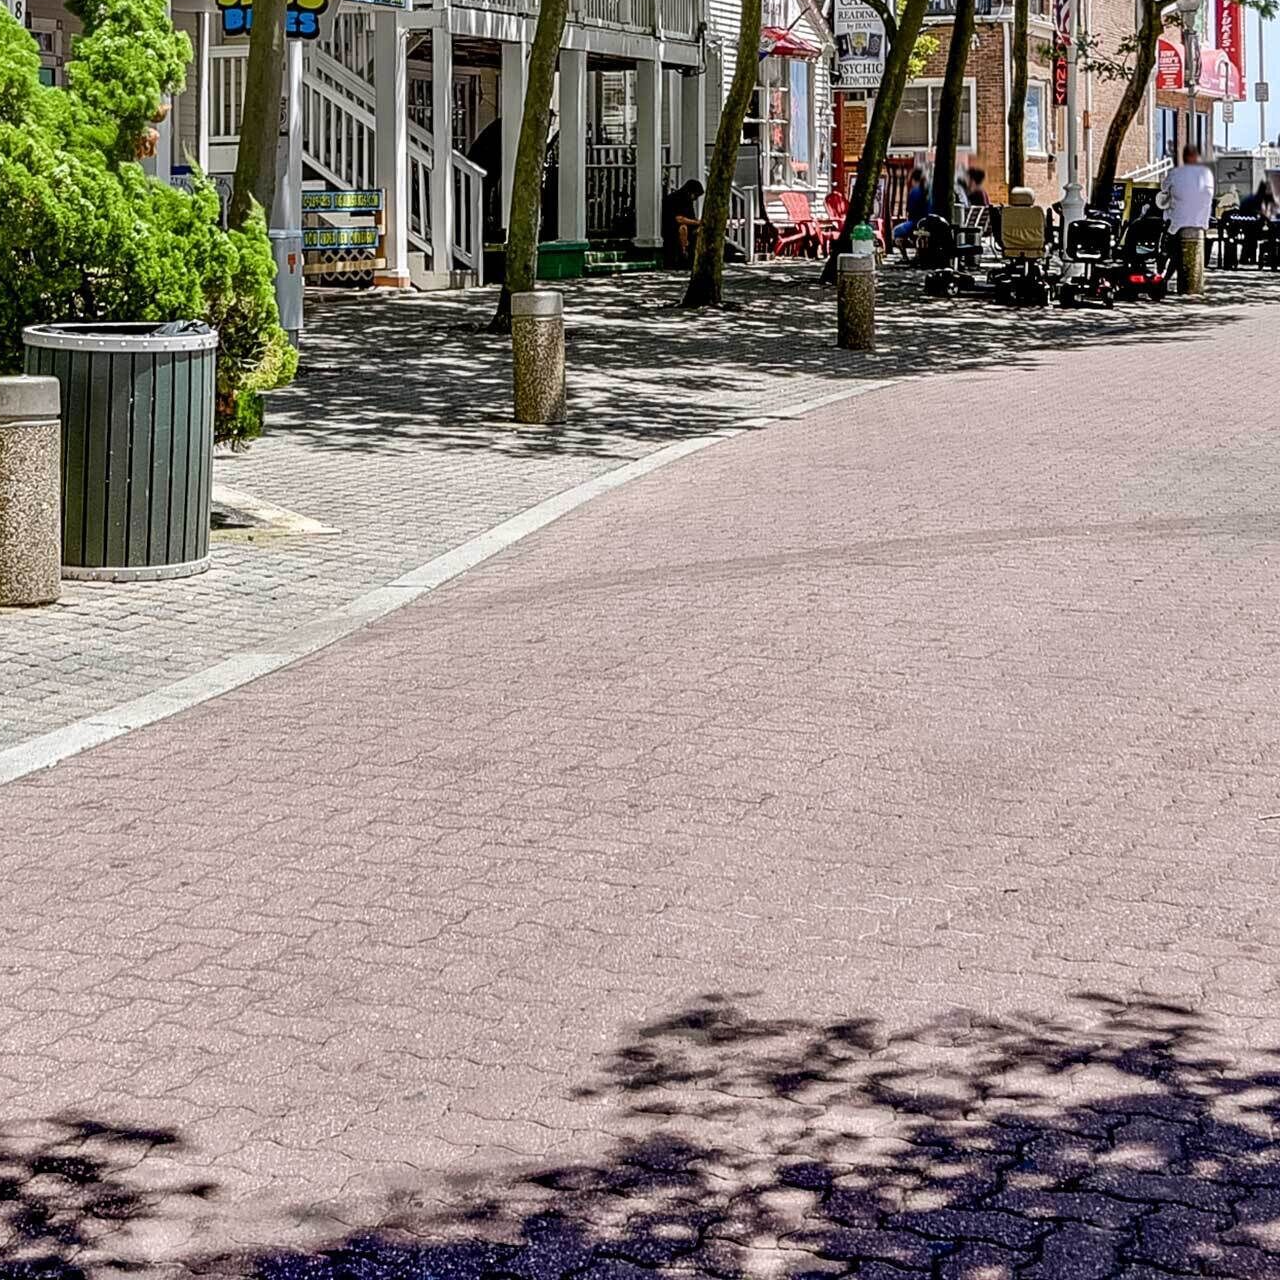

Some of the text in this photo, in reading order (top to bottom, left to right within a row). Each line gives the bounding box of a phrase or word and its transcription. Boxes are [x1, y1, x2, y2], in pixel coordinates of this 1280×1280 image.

[15, 1, 22, 19] 8
[224, 8, 316, 32] BIES
[838, 63, 882, 74] PSYCHIC
